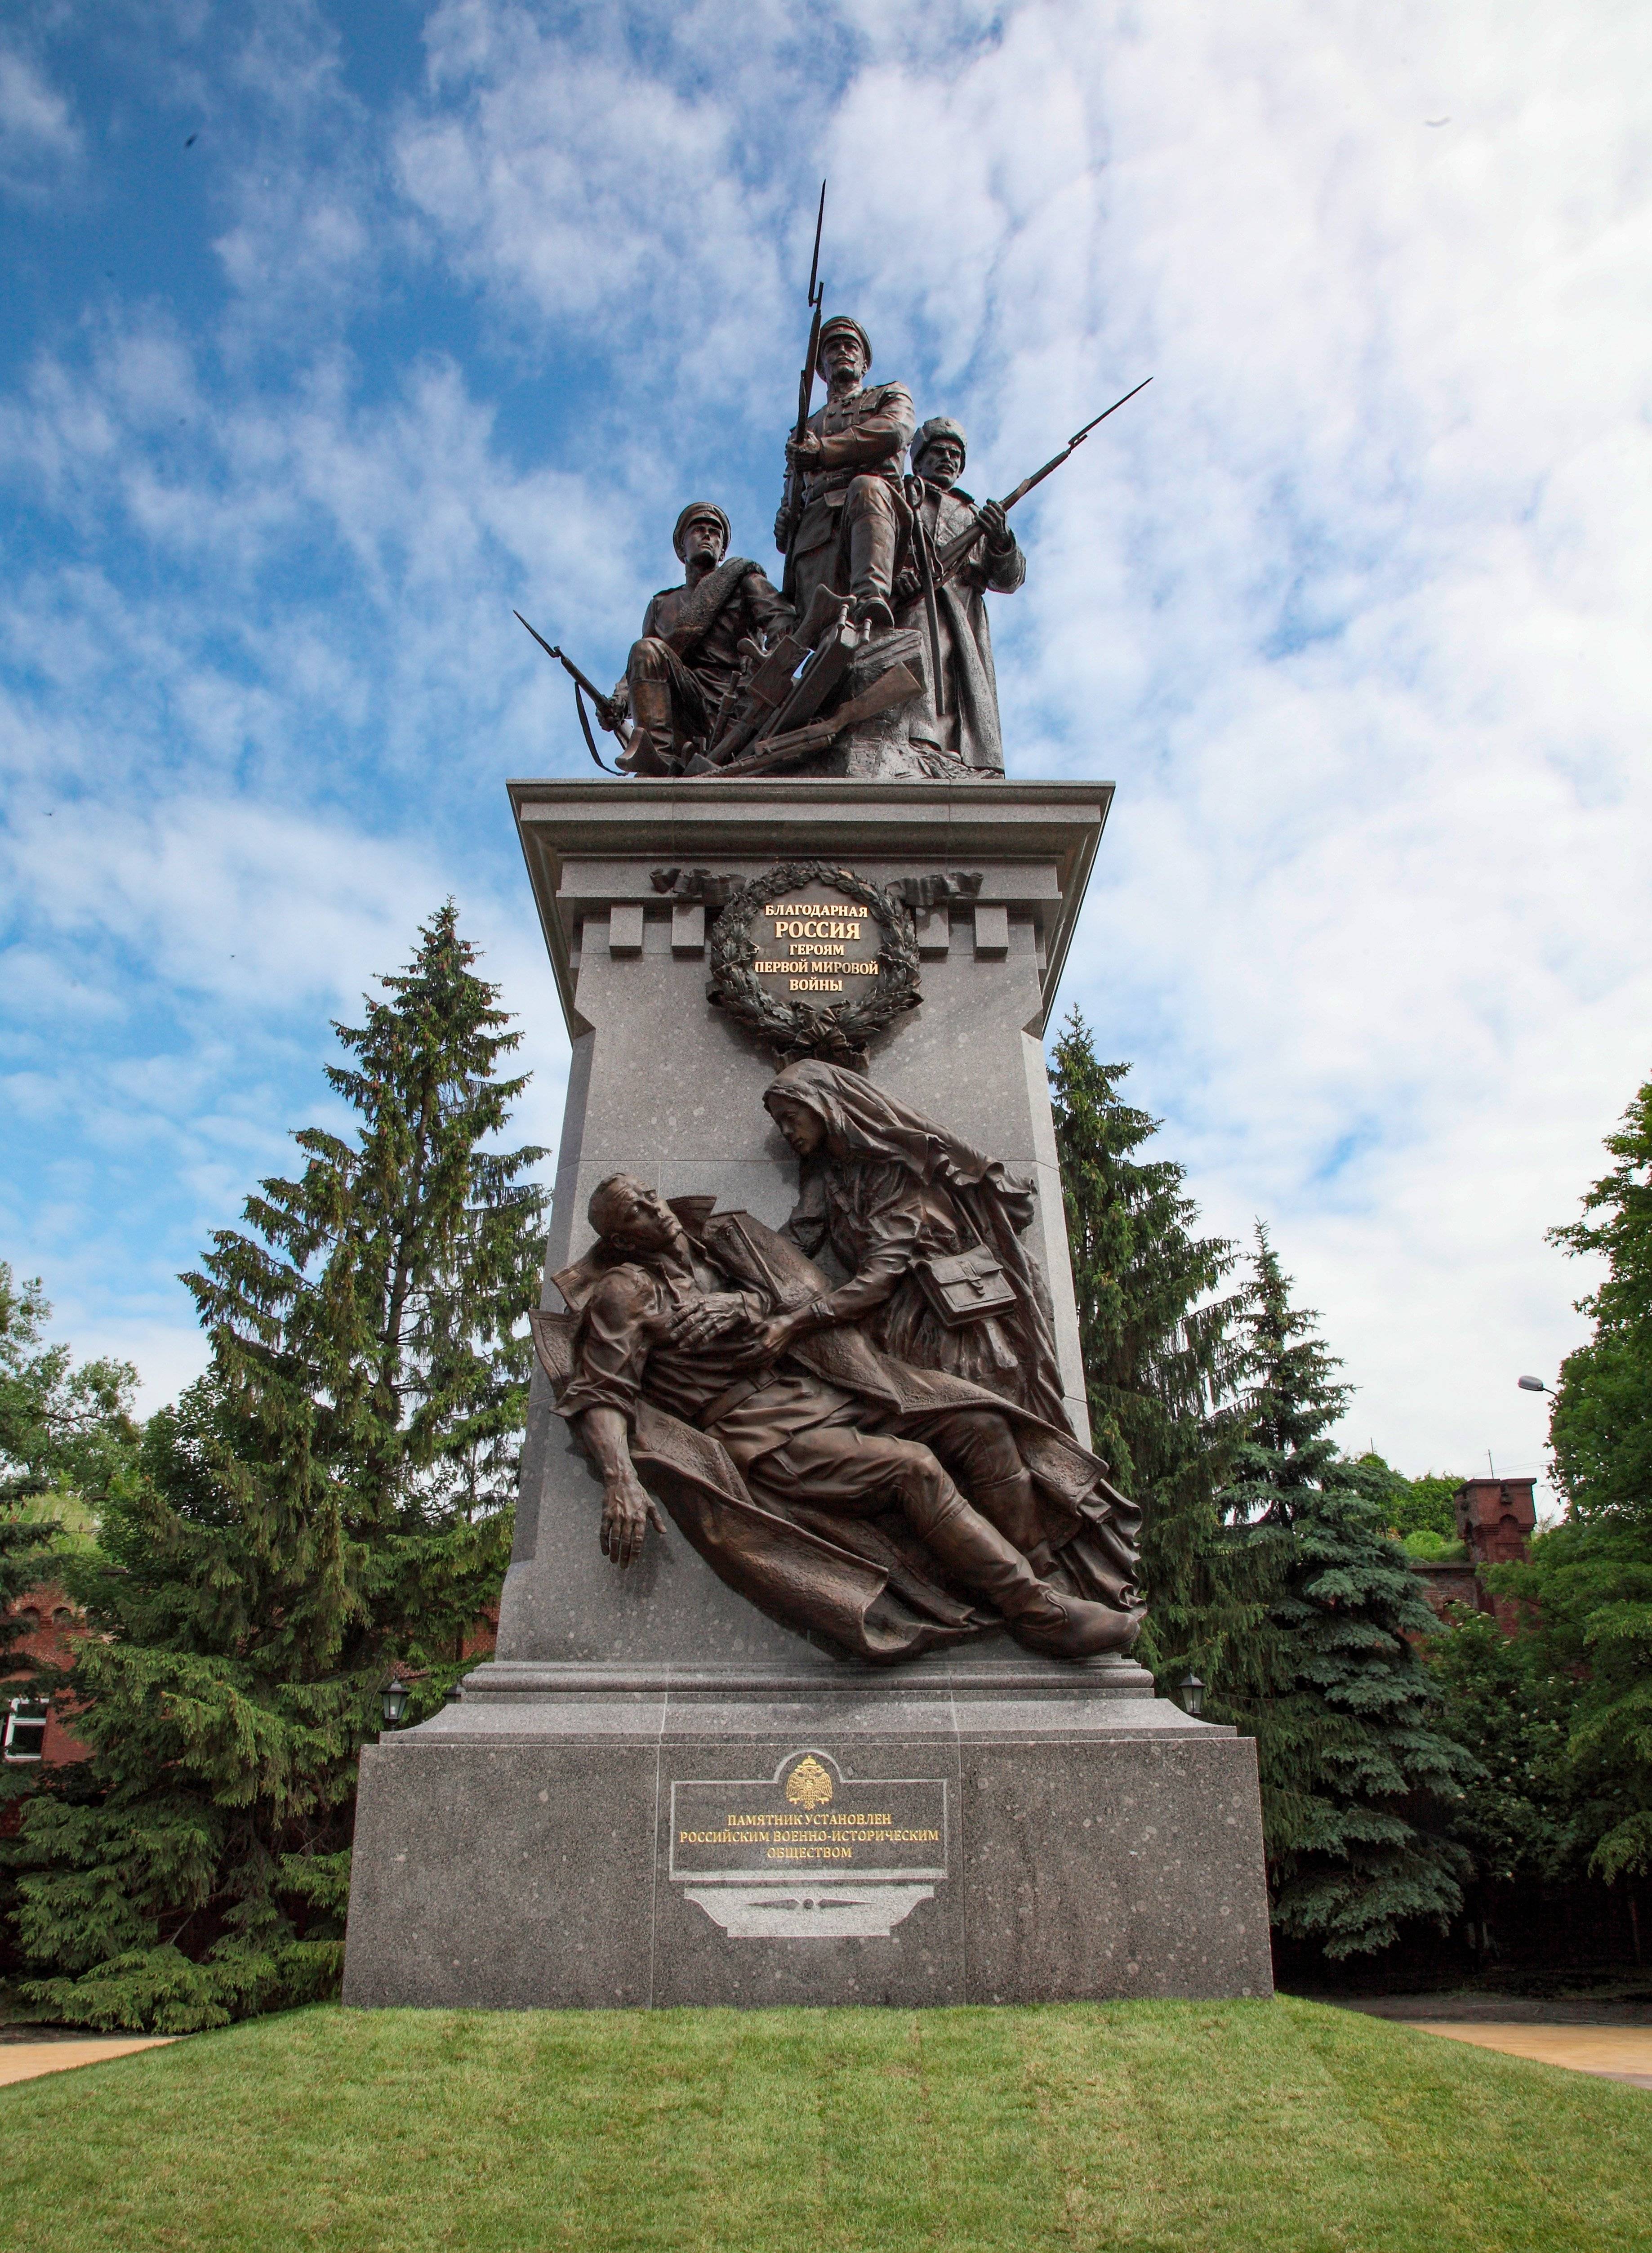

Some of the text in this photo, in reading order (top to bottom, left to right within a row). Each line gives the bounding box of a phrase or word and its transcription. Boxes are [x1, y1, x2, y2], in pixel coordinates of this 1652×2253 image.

[765, 904, 868, 918] БЛАГОДАРНАЯ
[775, 921, 860, 939] РОССИЯ
[789, 944, 845, 955] ГЕРОЯМ
[755, 959, 878, 974] ПЕРВОЙ МИРОВОЙ
[789, 976, 842, 991] ВОЙНЫ
[727, 1813, 891, 1825] ПАМЯТНИК УСТАНОВЛЕН
[680, 1829, 939, 1843] РОССИЙСКИМ ВОЕННО-ИСТОРИЧЕСКИМ
[767, 1847, 852, 1859] ОБЩЕСТВОМ
